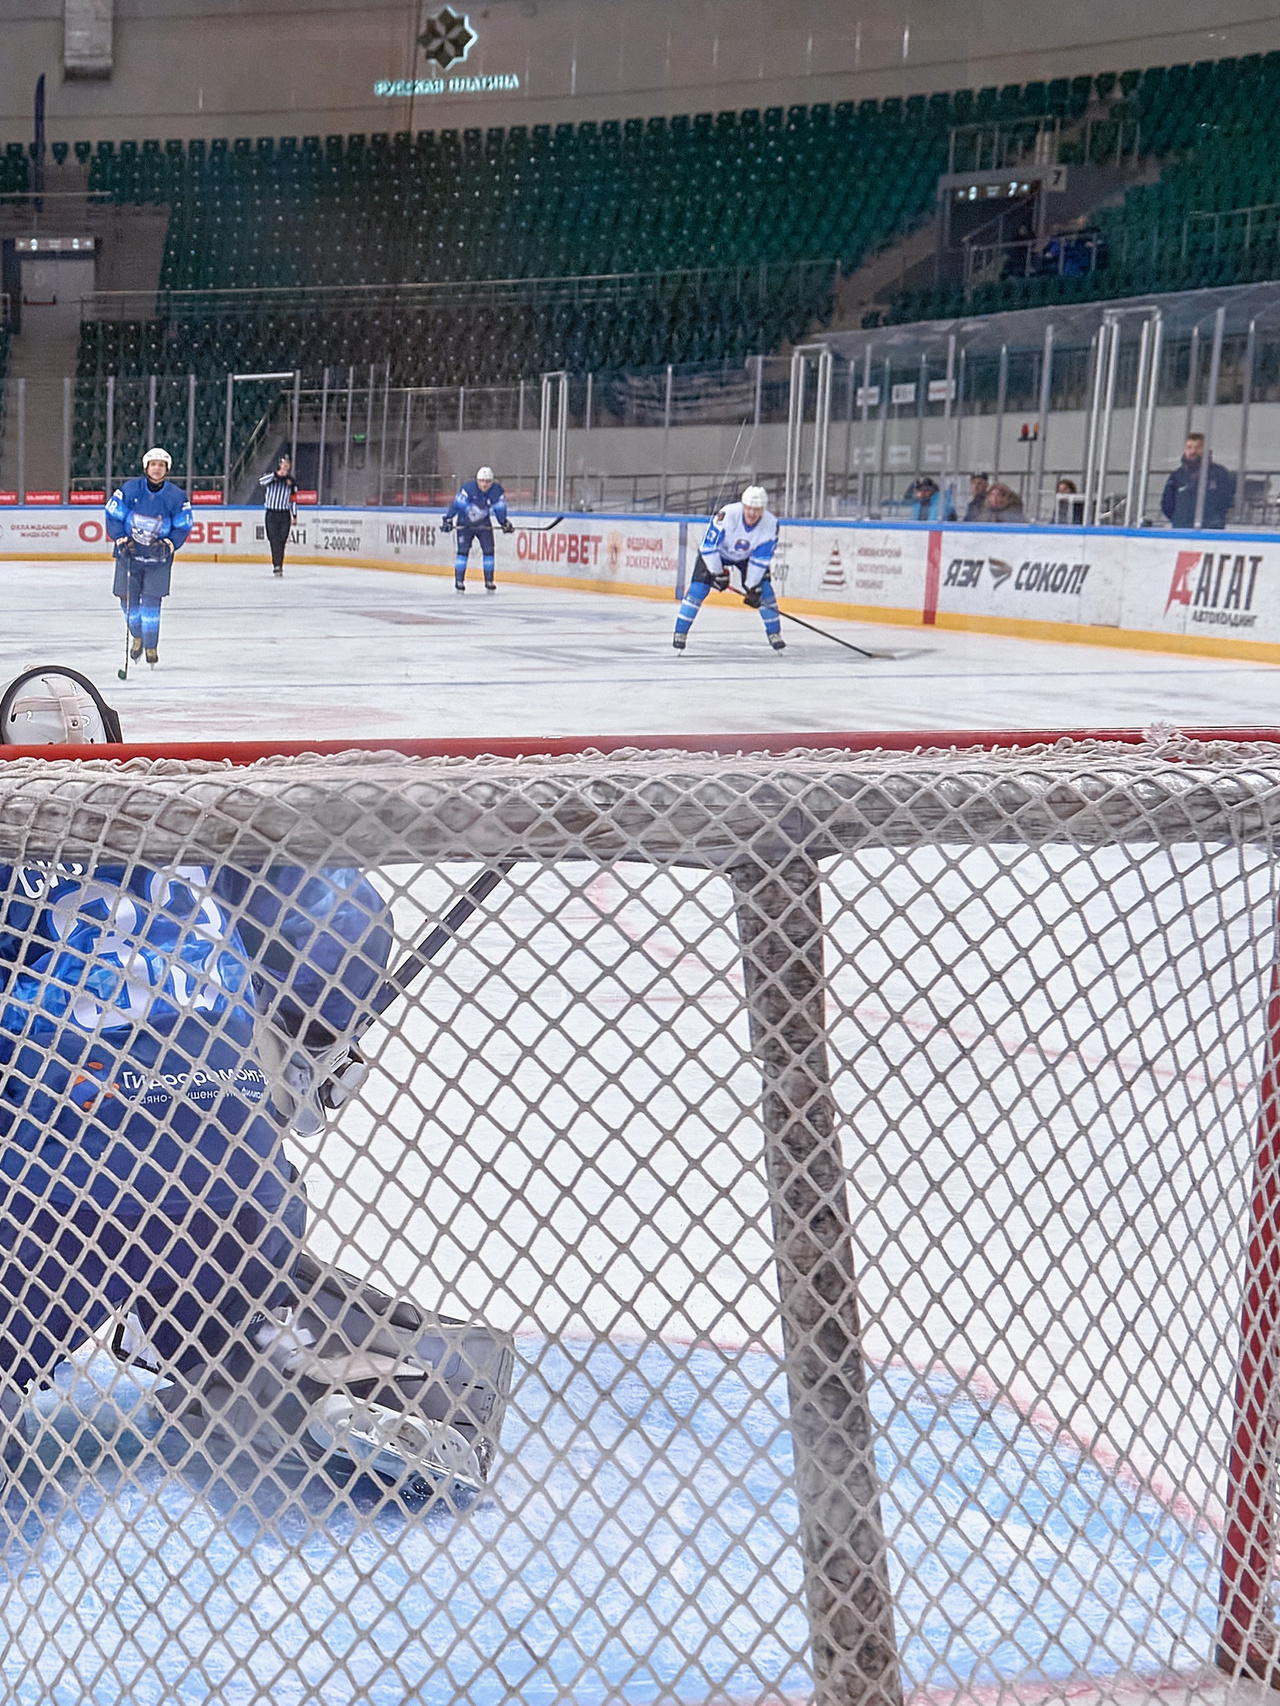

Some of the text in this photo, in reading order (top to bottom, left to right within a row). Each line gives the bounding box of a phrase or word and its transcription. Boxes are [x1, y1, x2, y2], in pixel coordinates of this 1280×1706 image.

[409, 524, 436, 547] TYRES
[516, 531, 603, 566] OLIMPBET
[1014, 560, 1091, 595] СОКОЛ!
[1193, 552, 1264, 611] АГАТ
